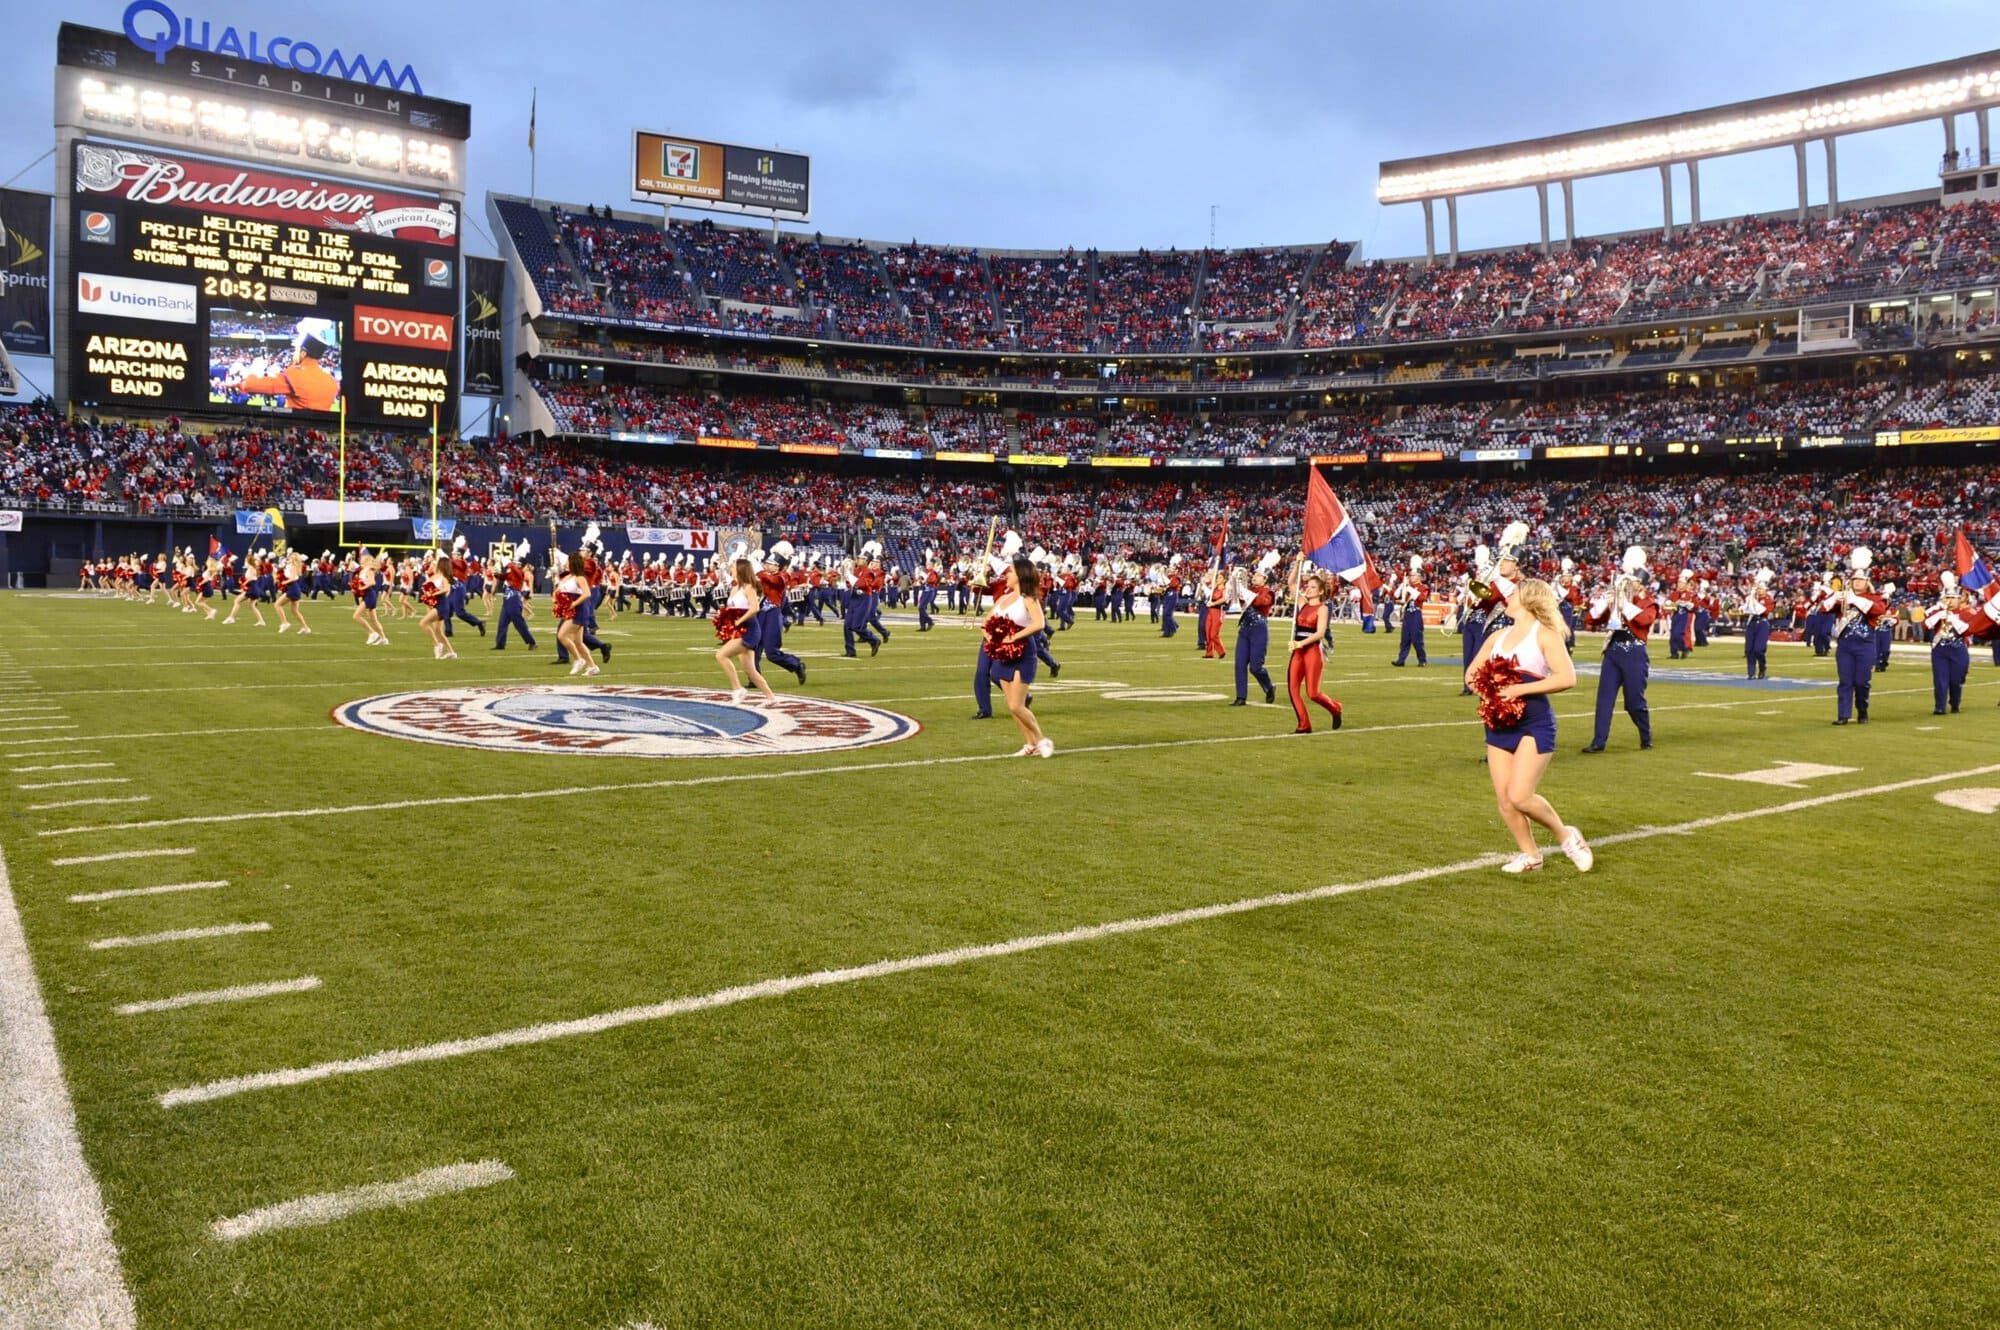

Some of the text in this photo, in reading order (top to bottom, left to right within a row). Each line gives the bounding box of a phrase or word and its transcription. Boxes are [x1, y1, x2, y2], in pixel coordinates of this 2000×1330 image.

[122, 0, 423, 96] QUALCOMM
[191, 61, 400, 112] STADIUM
[113, 160, 375, 214] Budweiser
[727, 171, 805, 190] Imaging Healthcare
[746, 192, 768, 200] Partner
[203, 215, 350, 248] WELCOME TO THE
[377, 213, 453, 229] American Lager
[140, 221, 402, 269] PACIFIC LIFE HOLIDAY BOWL
[150, 238, 395, 280] PRE-GAME SHOW PRESENTED BY THE
[1, 270, 47, 288] Sprint
[133, 248, 187, 267] SYCUAN
[193, 256, 229, 271] BAND
[236, 262, 254, 274] OF
[261, 265, 286, 279] THE
[362, 278, 409, 295] NATION
[204, 276, 266, 301] 20:52
[359, 316, 448, 342] TOYOTA
[465, 325, 501, 341] Sprint
[86, 335, 187, 361] ARIZONA
[89, 358, 185, 380] MARCHING
[363, 362, 448, 386] ARIZONA
[111, 378, 163, 396] BAND
[365, 382, 445, 402] MARCHING
[383, 401, 426, 417] BAND
[700, 437, 756, 449] WELLS FARGO
[1340, 454, 1368, 463] FARGO
[690, 532, 709, 548] N
